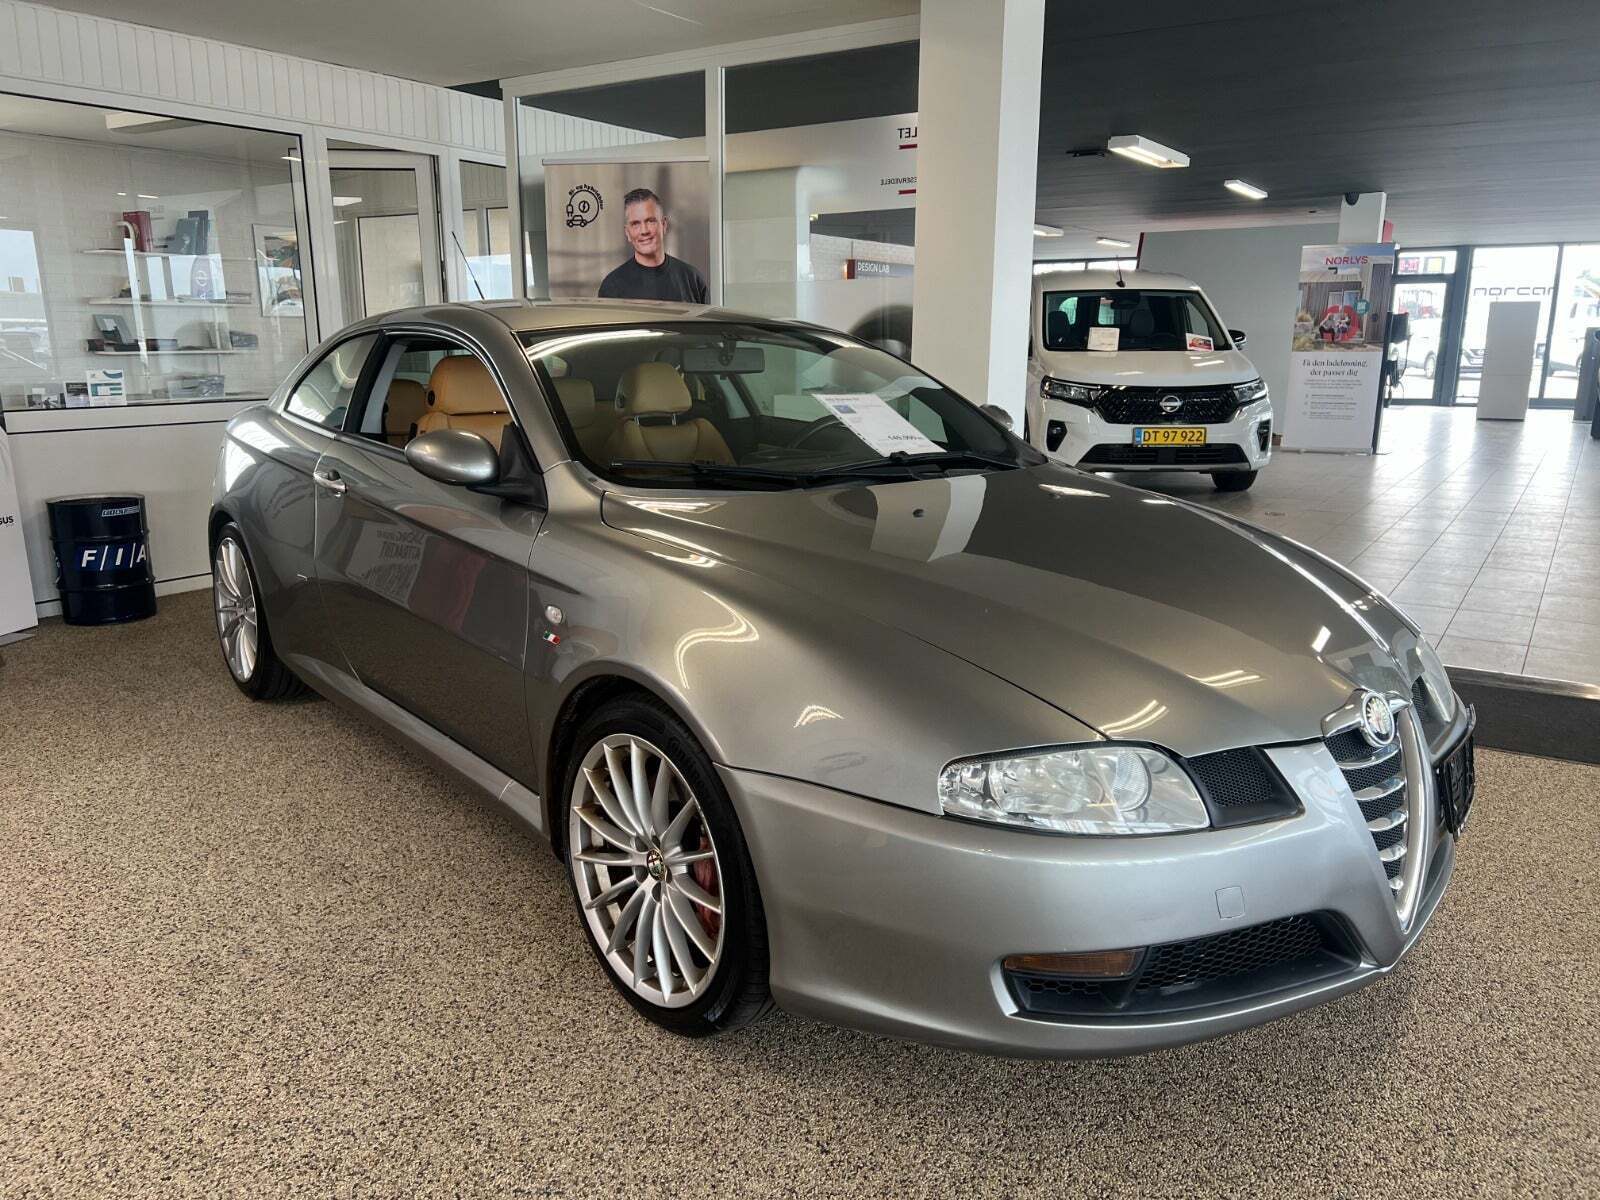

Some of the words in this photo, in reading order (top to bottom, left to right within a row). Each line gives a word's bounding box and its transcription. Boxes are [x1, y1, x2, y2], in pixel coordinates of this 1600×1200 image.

[1325, 255, 1369, 265] NORLYS
[857, 262, 878, 272] DESIGN
[879, 264, 890, 274] LAB
[1143, 430, 1160, 442] DT
[1163, 430, 1178, 442] 97
[1181, 430, 1203, 442] 922
